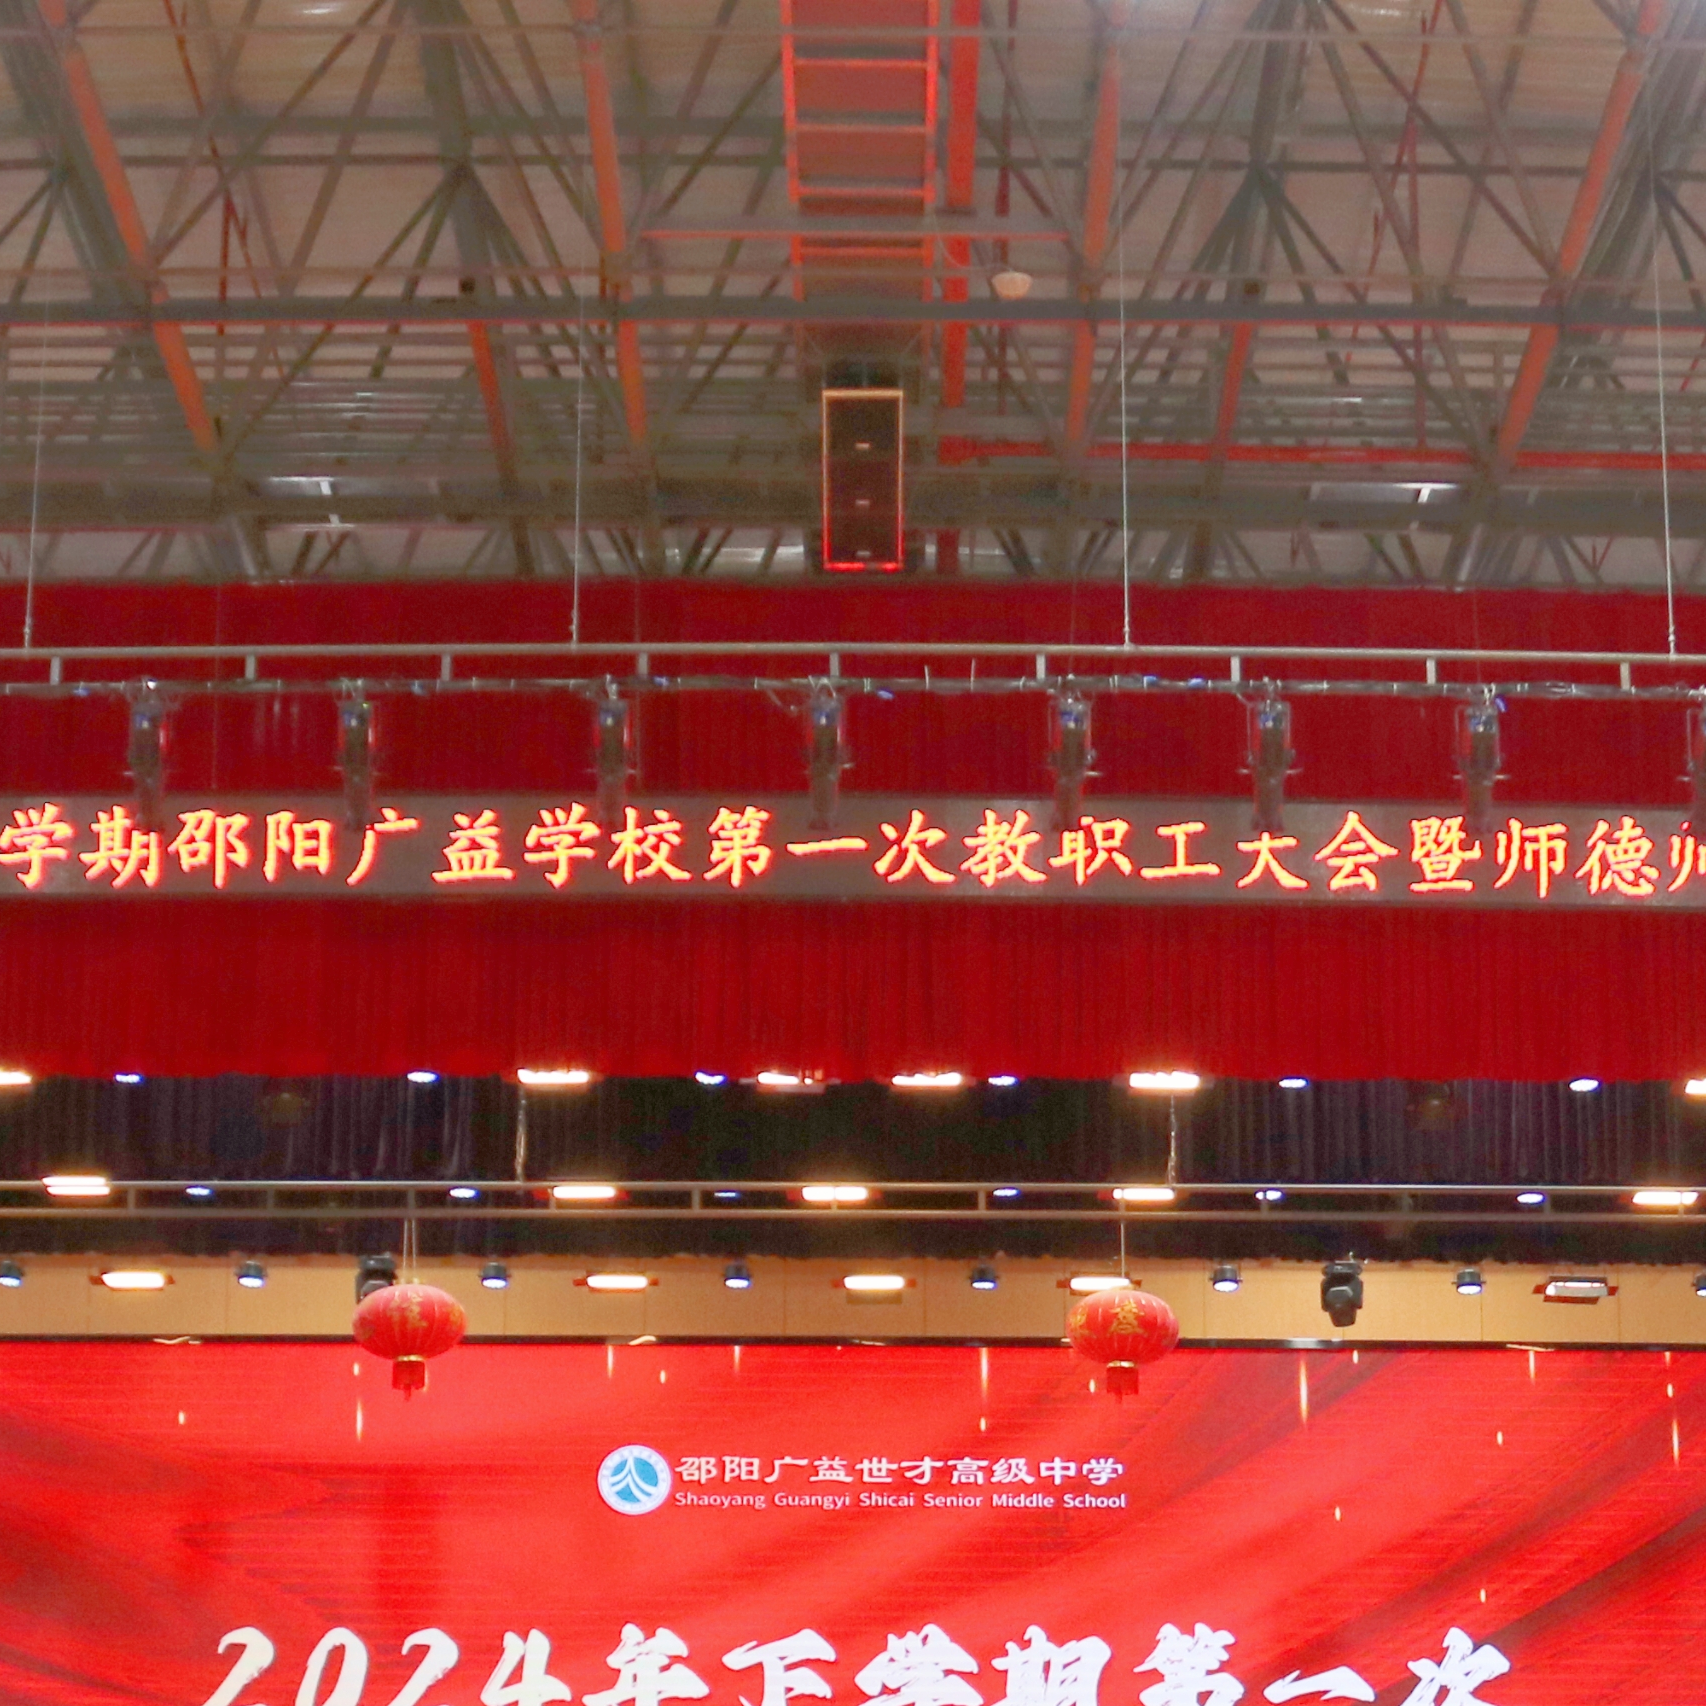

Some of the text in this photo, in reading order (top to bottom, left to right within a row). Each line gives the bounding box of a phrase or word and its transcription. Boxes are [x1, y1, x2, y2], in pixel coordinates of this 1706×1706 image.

[674, 1455, 1124, 1486] 邵阳广益世才高级中学
[675, 1491, 1126, 1510] Shaoyang Guangyi Shicai Senior Middle School
